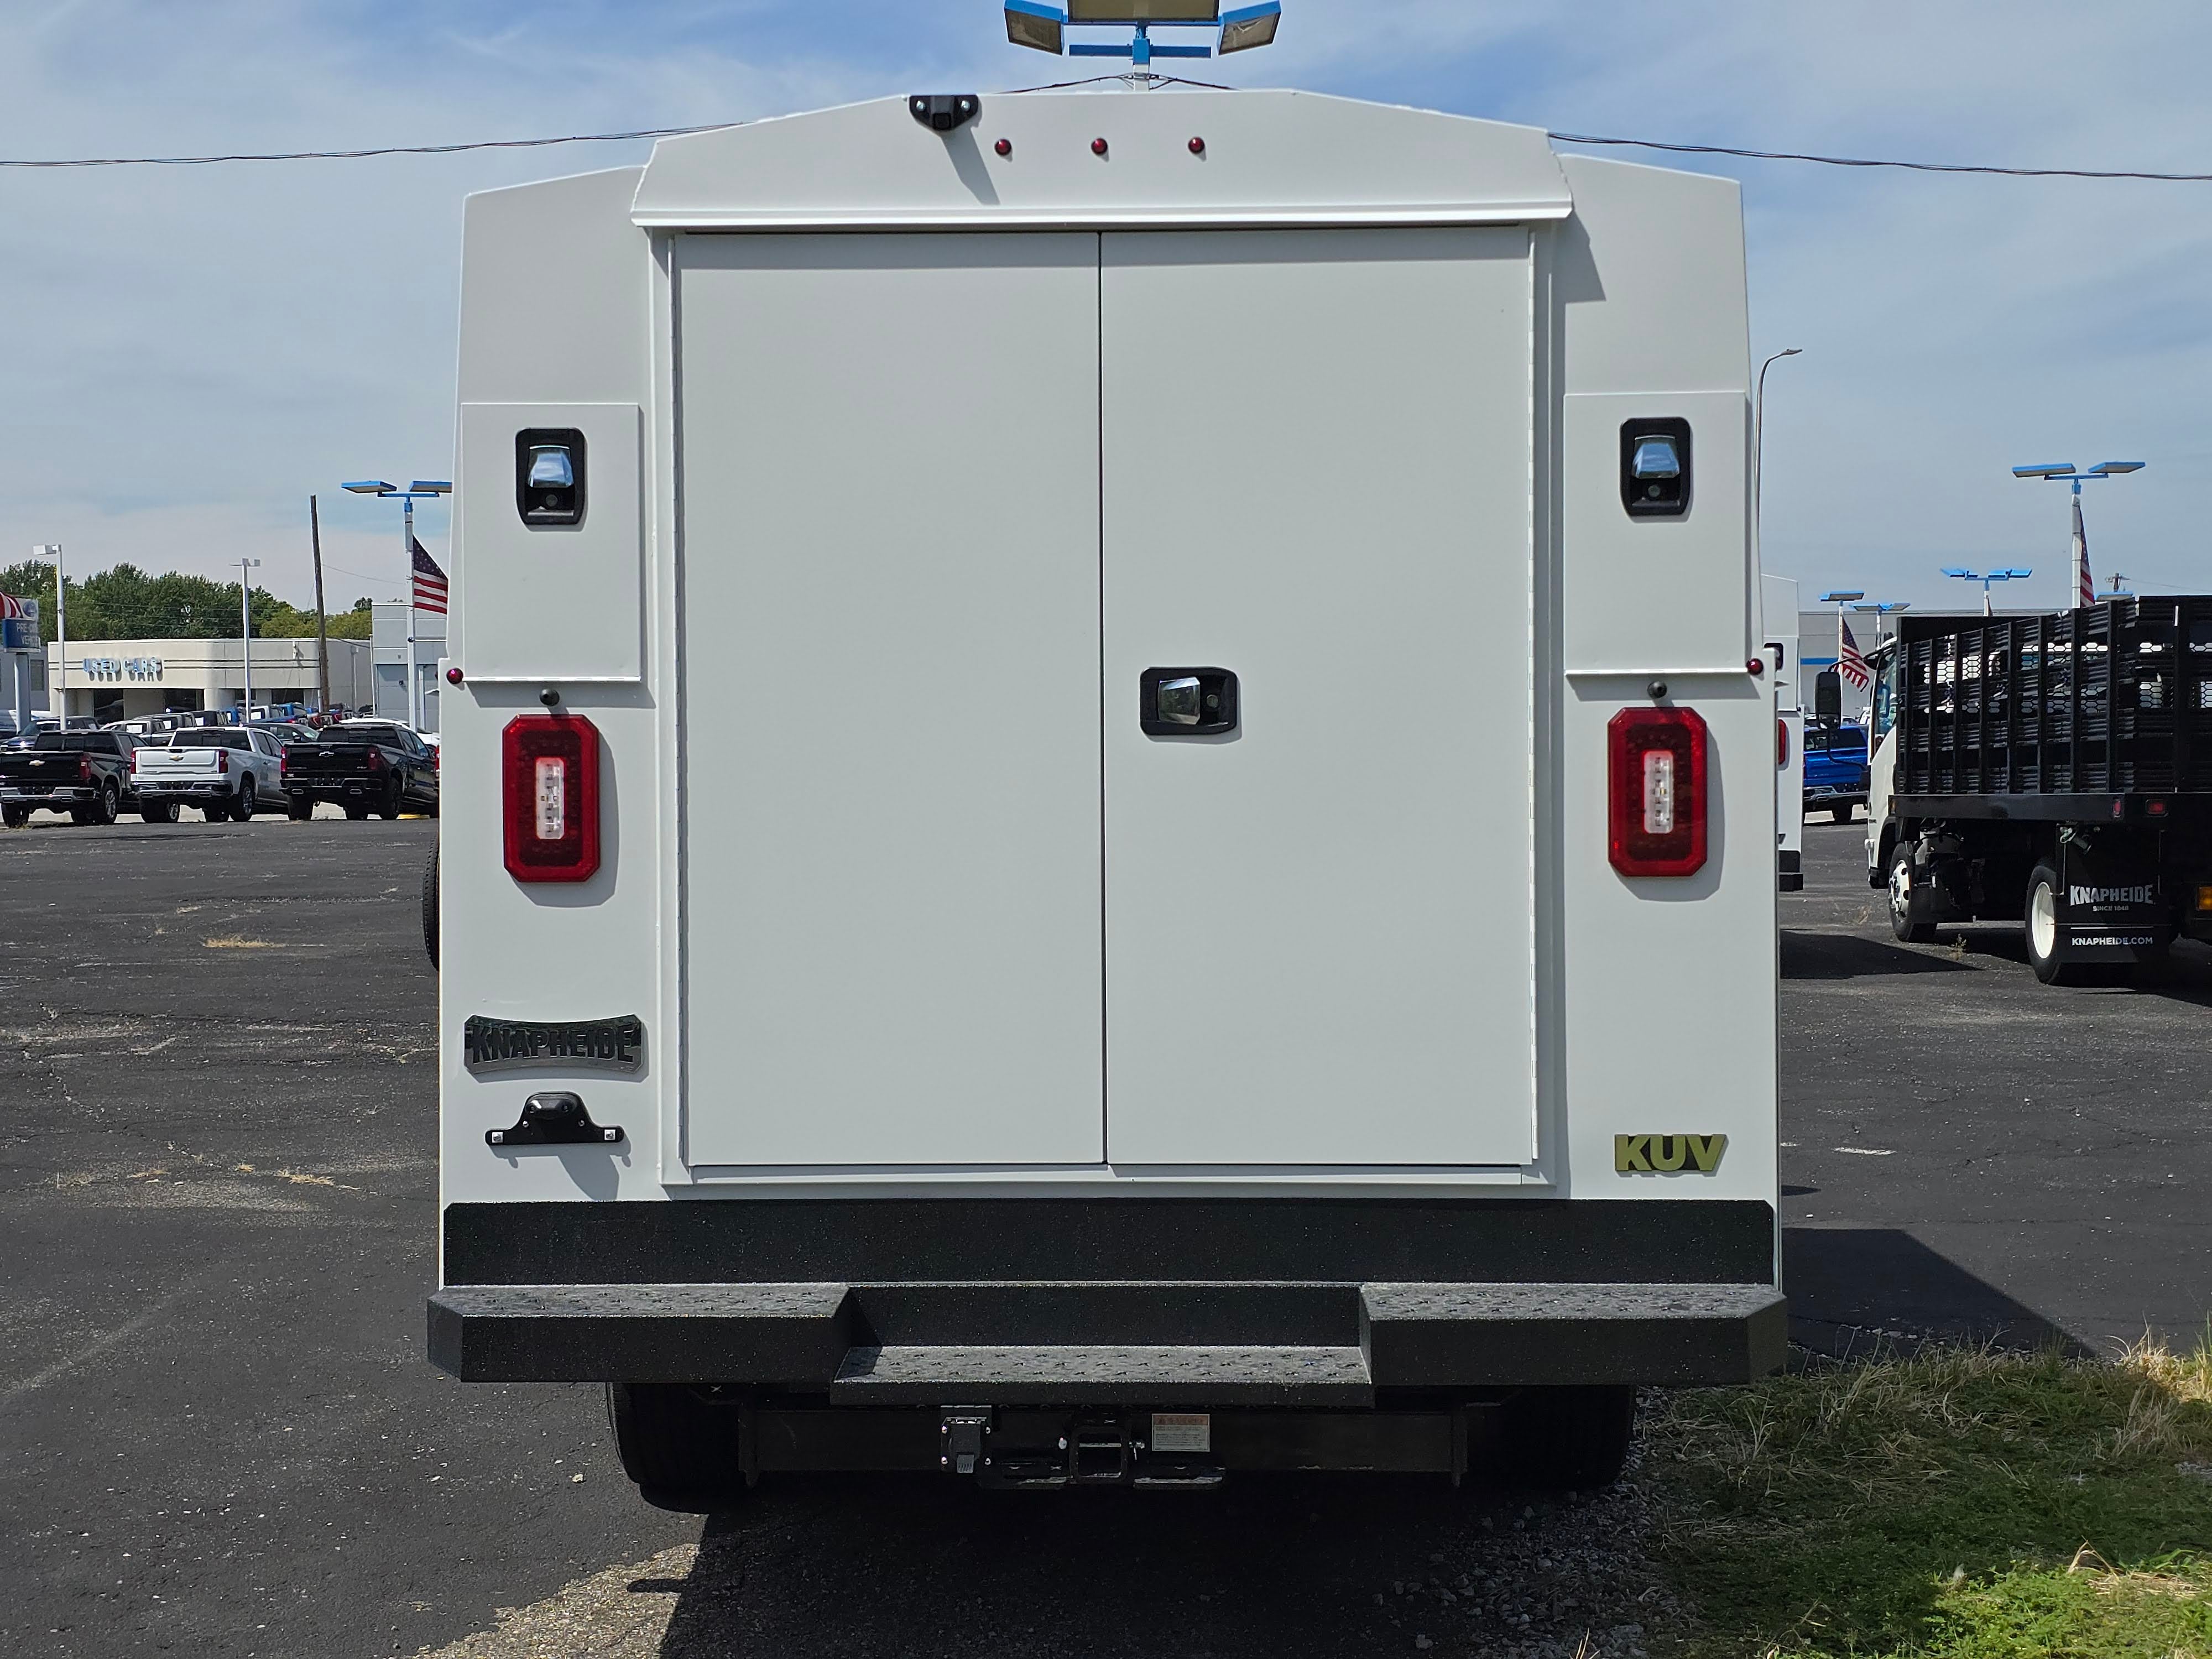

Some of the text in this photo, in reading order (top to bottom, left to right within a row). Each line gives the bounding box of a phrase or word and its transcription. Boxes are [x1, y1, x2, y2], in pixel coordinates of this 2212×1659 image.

[83, 657, 162, 673] USED CARS
[2070, 884, 2153, 906] KNAPHEIDE
[2072, 936, 2153, 946] KNAPHEIDE.COM
[471, 1023, 634, 1065] KNAPHEIDE
[1614, 1134, 1727, 1171] KUV
